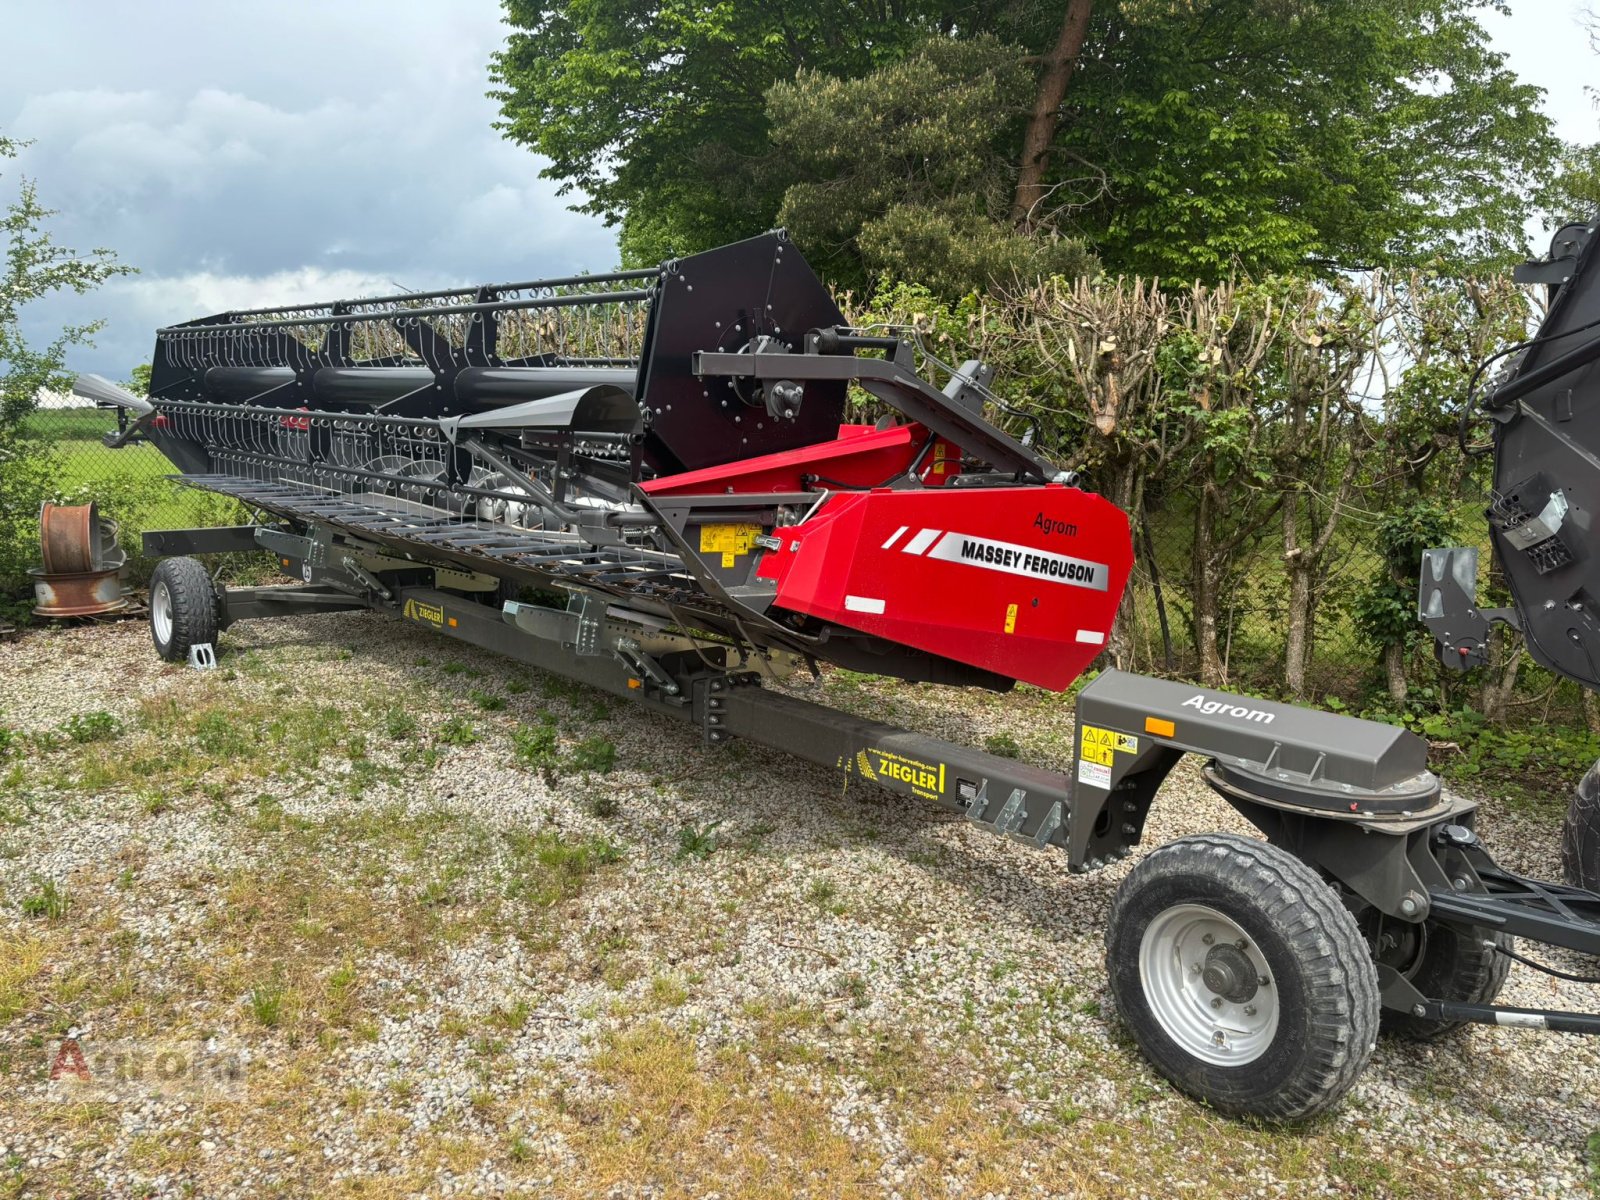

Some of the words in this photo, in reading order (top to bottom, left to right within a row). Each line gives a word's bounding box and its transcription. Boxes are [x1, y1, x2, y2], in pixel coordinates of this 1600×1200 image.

[1033, 512, 1078, 537] Agrom
[961, 540, 1022, 569] MASSEY
[1024, 554, 1095, 583] FERGUSON
[419, 607, 441, 623] ZIEGLER
[1181, 695, 1276, 725] Agrom
[879, 758, 938, 791] ZIEGLER
[912, 786, 939, 801] Transport
